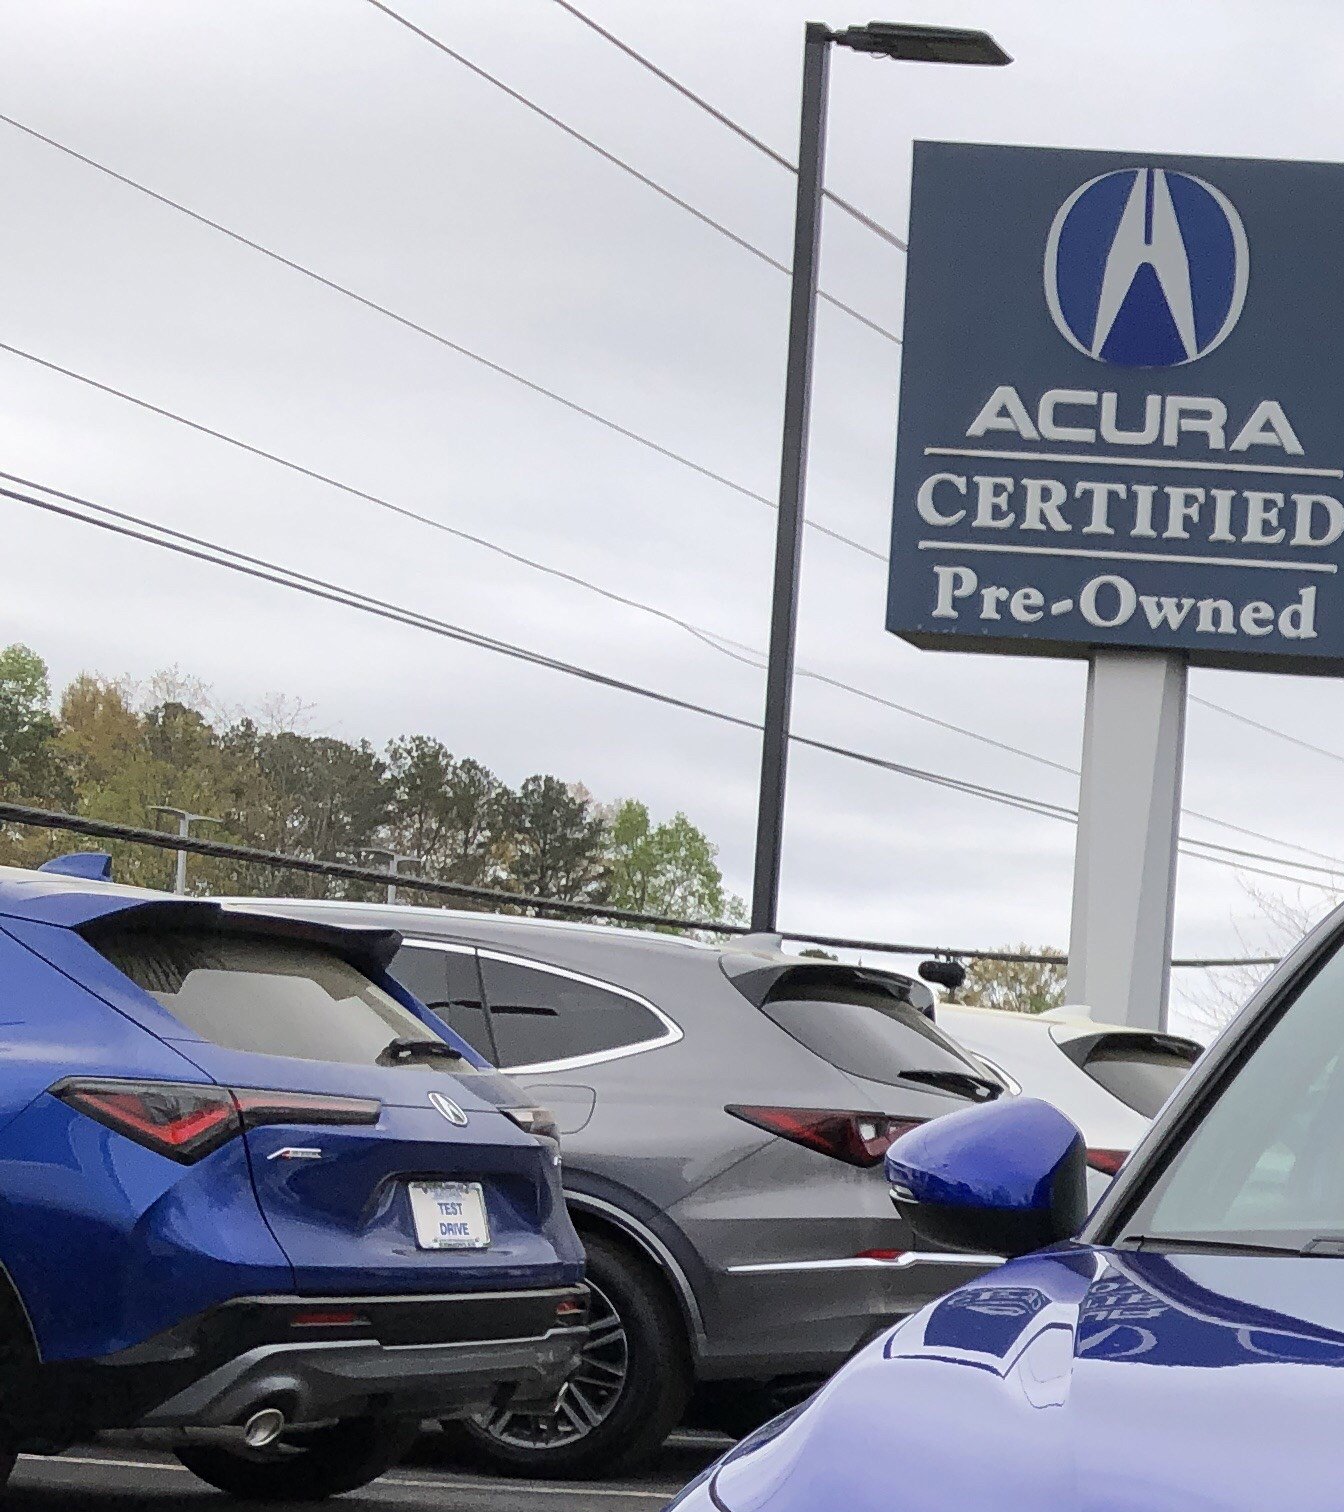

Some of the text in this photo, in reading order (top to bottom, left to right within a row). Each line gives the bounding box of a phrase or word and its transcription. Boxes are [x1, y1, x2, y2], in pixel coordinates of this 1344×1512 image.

[966, 386, 1304, 454] ACURA
[931, 565, 1318, 639] Pre-Owned
[437, 1202, 463, 1215] TEST
[439, 1222, 470, 1236] DRIVE
